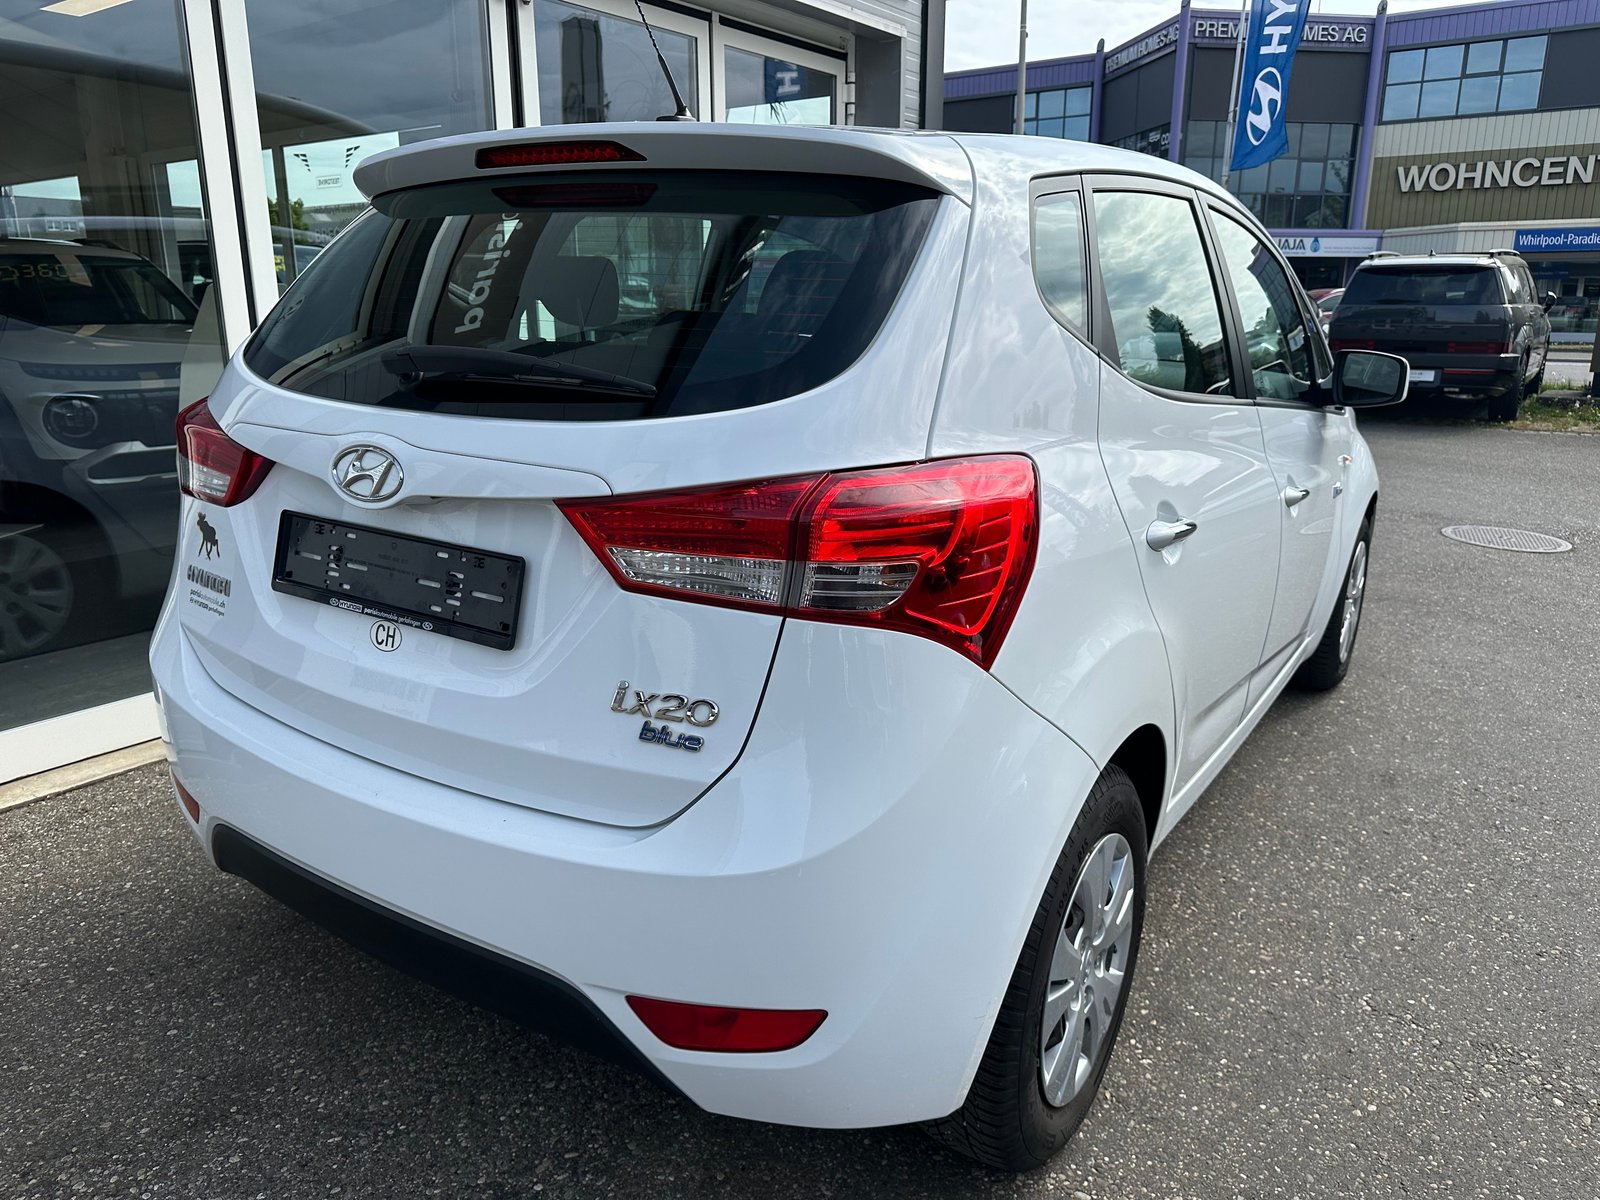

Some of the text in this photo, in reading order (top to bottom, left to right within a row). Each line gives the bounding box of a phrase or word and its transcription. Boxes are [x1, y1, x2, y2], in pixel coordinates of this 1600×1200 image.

[1194, 20, 1368, 43] PREMI MES AG
[1105, 45, 1137, 74] PREMIUM
[1138, 29, 1167, 57] HOMES
[1397, 154, 1600, 193] WOHNCEN
[375, 623, 396, 648] CH
[611, 680, 720, 727] ix20
[639, 720, 704, 753] blue
